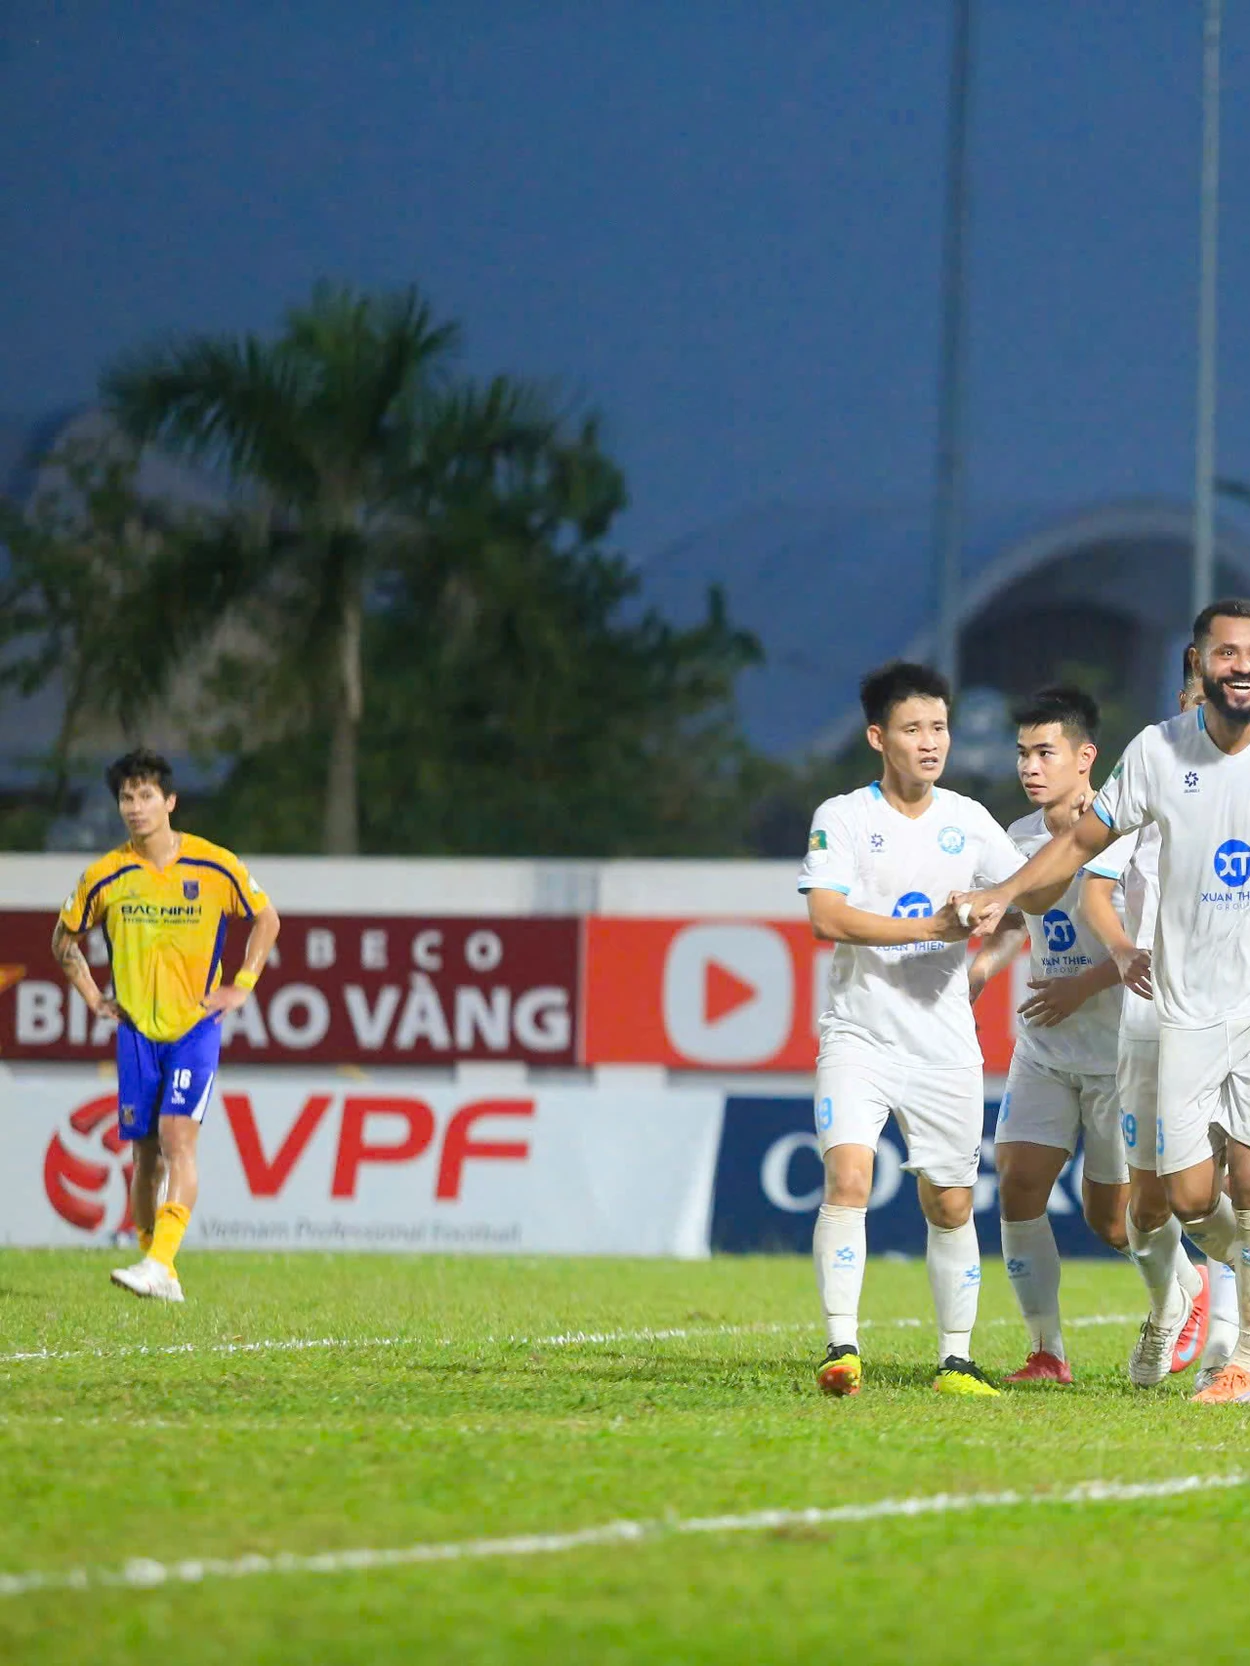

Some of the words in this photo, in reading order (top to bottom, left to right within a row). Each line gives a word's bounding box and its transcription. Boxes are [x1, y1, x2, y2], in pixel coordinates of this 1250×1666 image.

[160, 905, 202, 916] NINH
[344, 971, 571, 1053] VÀNG
[173, 1069, 192, 1090] 16
[221, 1090, 536, 1203] VPF
